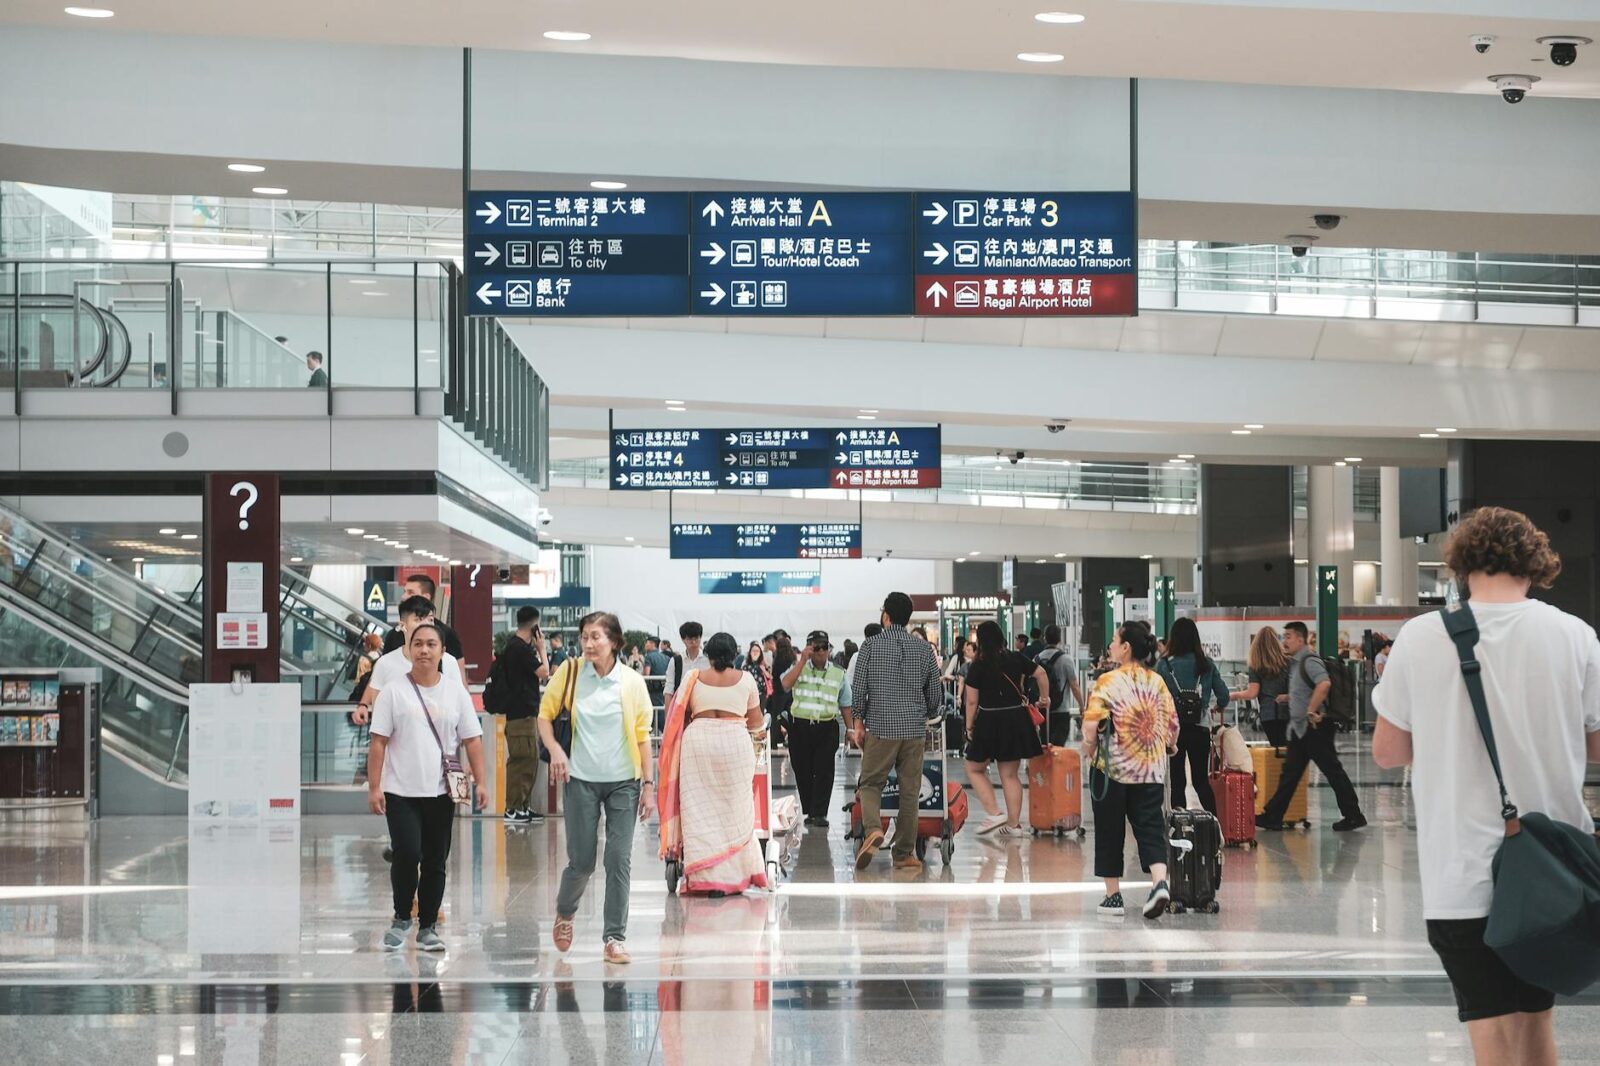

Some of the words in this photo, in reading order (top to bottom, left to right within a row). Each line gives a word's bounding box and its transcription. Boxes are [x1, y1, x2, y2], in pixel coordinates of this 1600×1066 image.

[509, 205, 530, 220] T2
[536, 197, 646, 215] 二號客運大樓
[731, 197, 803, 214] 接機大堂
[984, 198, 1036, 215] 停車場
[807, 200, 832, 226] A
[1041, 200, 1059, 227] 3
[536, 215, 587, 227] Terminal
[590, 215, 598, 227] 2
[731, 215, 776, 227] Arrivals
[780, 215, 801, 227] Hall
[983, 215, 1005, 227] Car
[1007, 215, 1032, 227] Park
[569, 238, 623, 256] 往市區
[761, 238, 871, 255] 團隊/酒店巴士
[984, 238, 1114, 256] 往內地/澳門交通
[568, 257, 583, 268] To
[586, 256, 607, 270] city
[762, 256, 820, 268] Tour/Hotel
[824, 256, 859, 268] Coach
[984, 256, 1077, 269] Mainland/Macao
[1078, 256, 1131, 270] Transport
[536, 278, 572, 296] 銀行
[984, 278, 1092, 296] 富豪機場酒店
[536, 295, 566, 307] Bank
[984, 296, 1015, 310] Regal
[1018, 296, 1059, 310] Airport
[1062, 296, 1092, 308] Hotel
[887, 431, 900, 445] A
[673, 452, 684, 466] 4
[778, 460, 790, 468] city
[770, 525, 777, 535] 4
[367, 583, 386, 602] A
